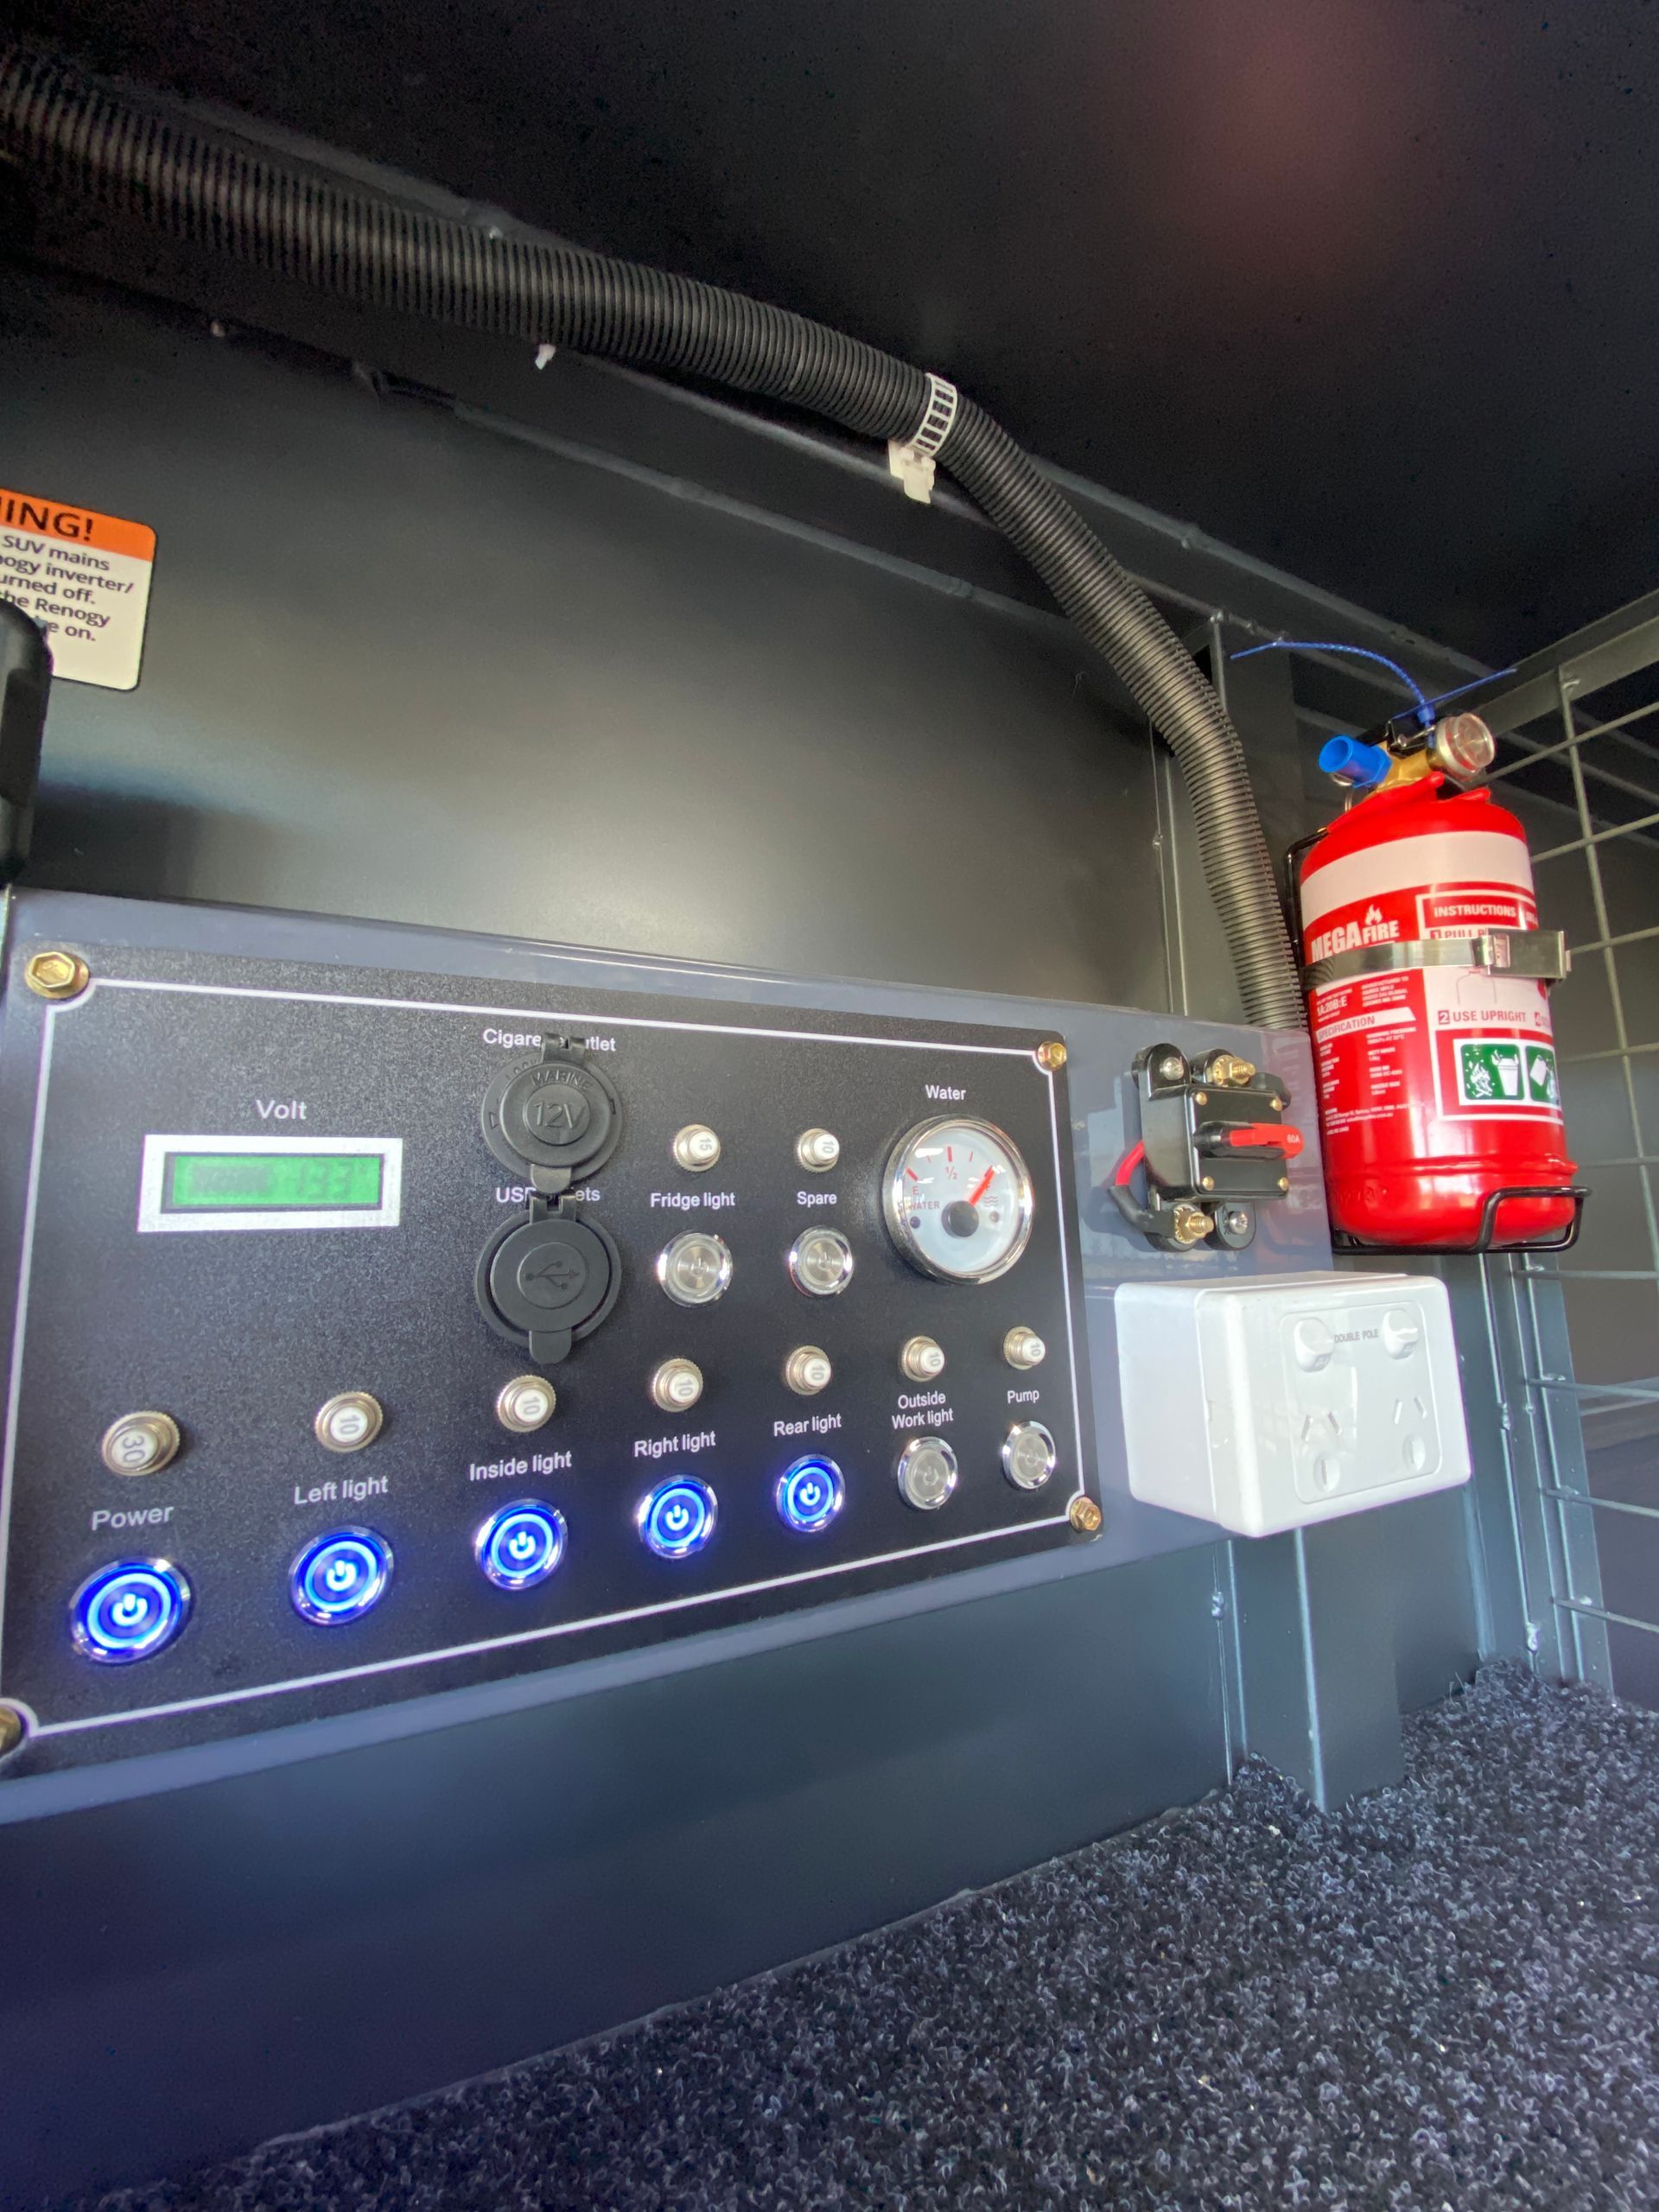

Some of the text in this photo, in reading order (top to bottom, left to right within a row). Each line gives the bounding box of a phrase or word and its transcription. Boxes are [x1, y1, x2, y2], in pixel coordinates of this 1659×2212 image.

[0, 496, 93, 542] ING!
[2, 535, 110, 571] SUV mains
[0, 555, 134, 594] ogy inverter/
[63, 587, 95, 605] off.
[35, 597, 111, 627] Renogy
[65, 624, 96, 642] on.
[1433, 903, 1516, 918] INSTRUCTIONS
[1452, 1011, 1478, 1022] USE
[1481, 1010, 1527, 1022] UPRIGHT
[1317, 1015, 1376, 1041] SPECIFICATION
[483, 1028, 617, 1052] Cigare tlet
[925, 1084, 967, 1101] Water
[255, 1098, 308, 1120] Volt
[532, 1099, 587, 1129] 12V
[650, 1192, 736, 1210] Fridge light
[797, 1191, 837, 1207] Spare
[1333, 1328, 1380, 1344] DOUBLE POLE
[898, 1390, 946, 1409] Outside
[1007, 1390, 1039, 1404] Pump
[773, 1413, 842, 1437] Rear light
[892, 1408, 954, 1429] Work light
[634, 1430, 716, 1459] Right light
[470, 1450, 572, 1481] Inside light
[294, 1476, 389, 1505] Left light
[91, 1504, 175, 1531] Power
